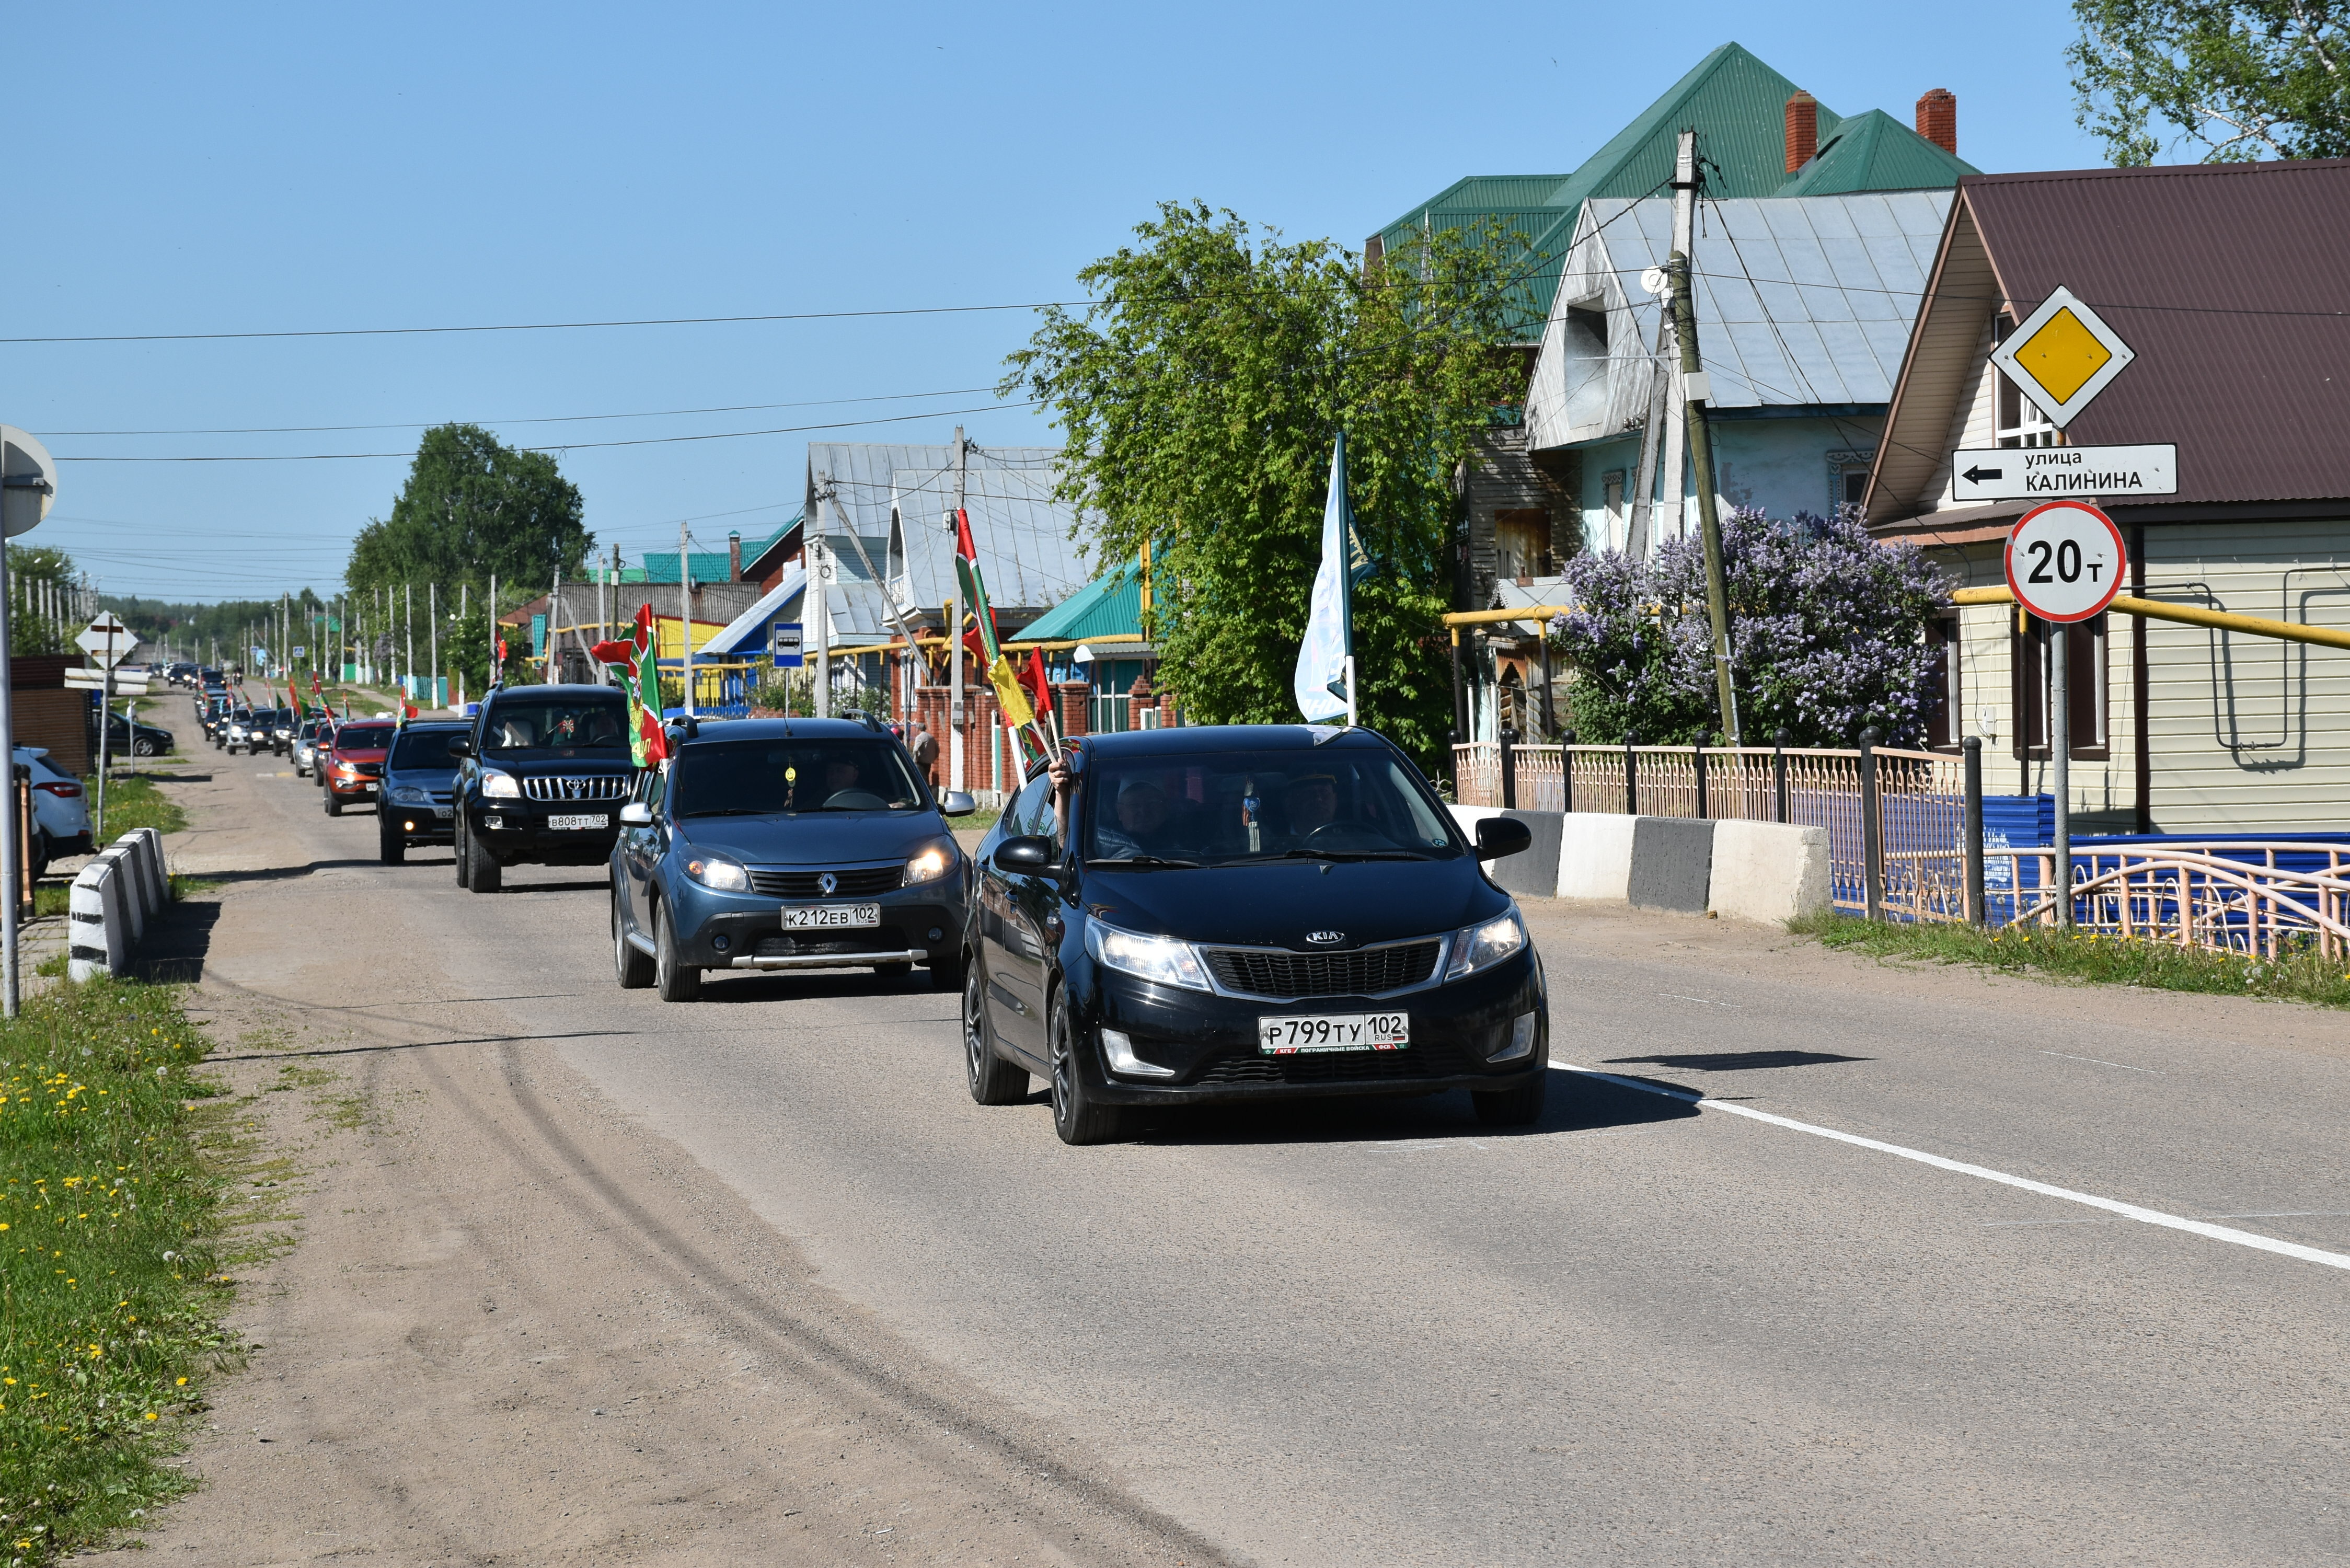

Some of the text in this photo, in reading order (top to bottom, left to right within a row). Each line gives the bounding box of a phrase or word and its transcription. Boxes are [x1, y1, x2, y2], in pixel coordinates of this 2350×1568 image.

[2025, 453, 2082, 469] улица
[2026, 471, 2143, 491] КАЛИНИНА
[551, 816, 589, 826] В808ТТ
[789, 907, 874, 926] К212ЕВ 102
[1312, 932, 1339, 941] KIA
[1269, 1016, 1402, 1044] Р799ТУ 102
